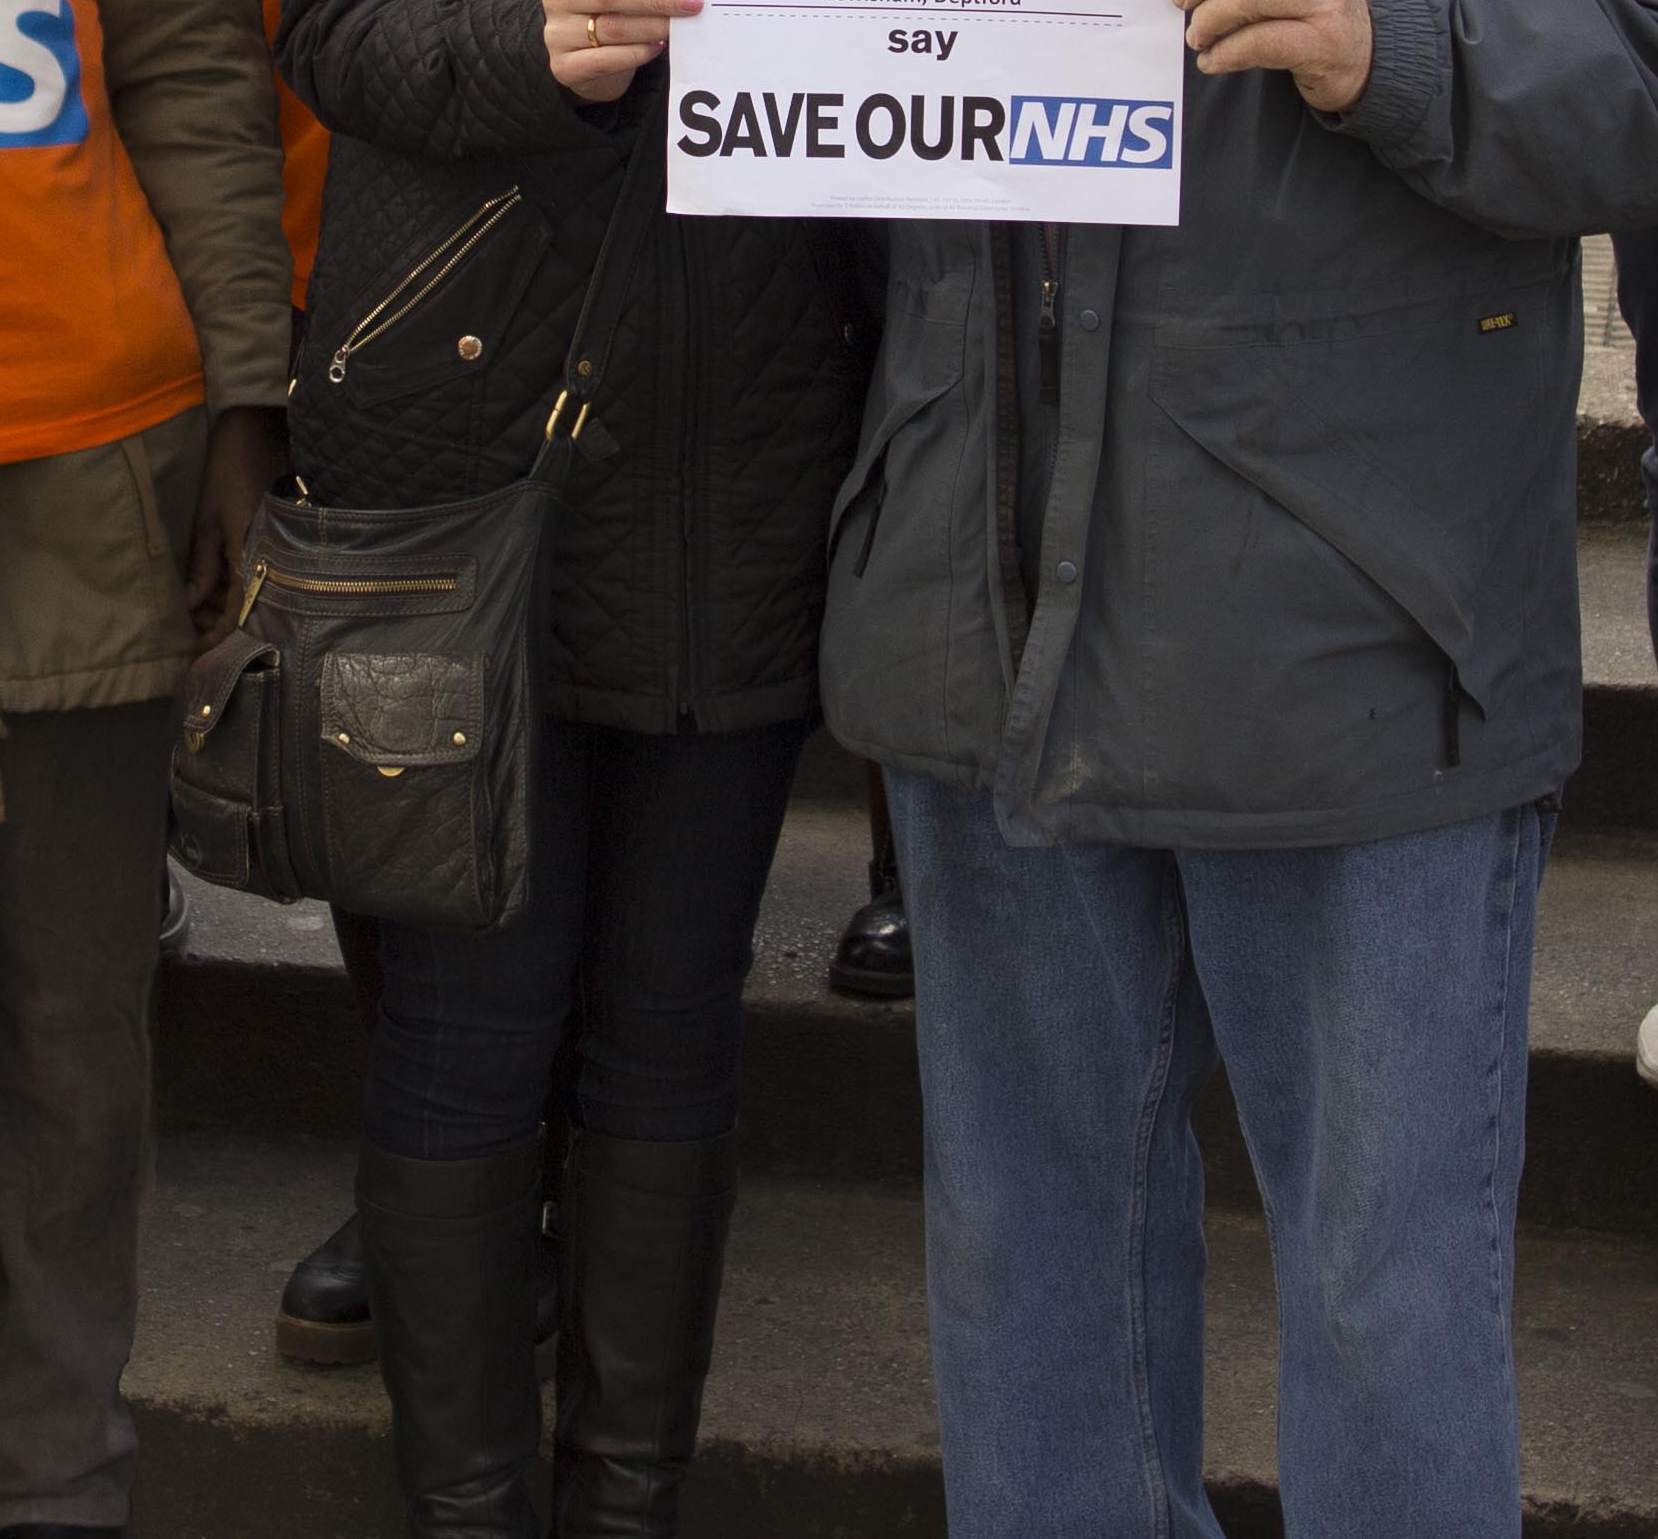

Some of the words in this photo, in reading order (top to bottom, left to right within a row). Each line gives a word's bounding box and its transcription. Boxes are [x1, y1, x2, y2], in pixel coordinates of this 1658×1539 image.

[886, 29, 959, 62] say
[677, 89, 846, 159] SAVE
[855, 92, 1006, 163] OUR
[1010, 101, 1174, 165] NHS
